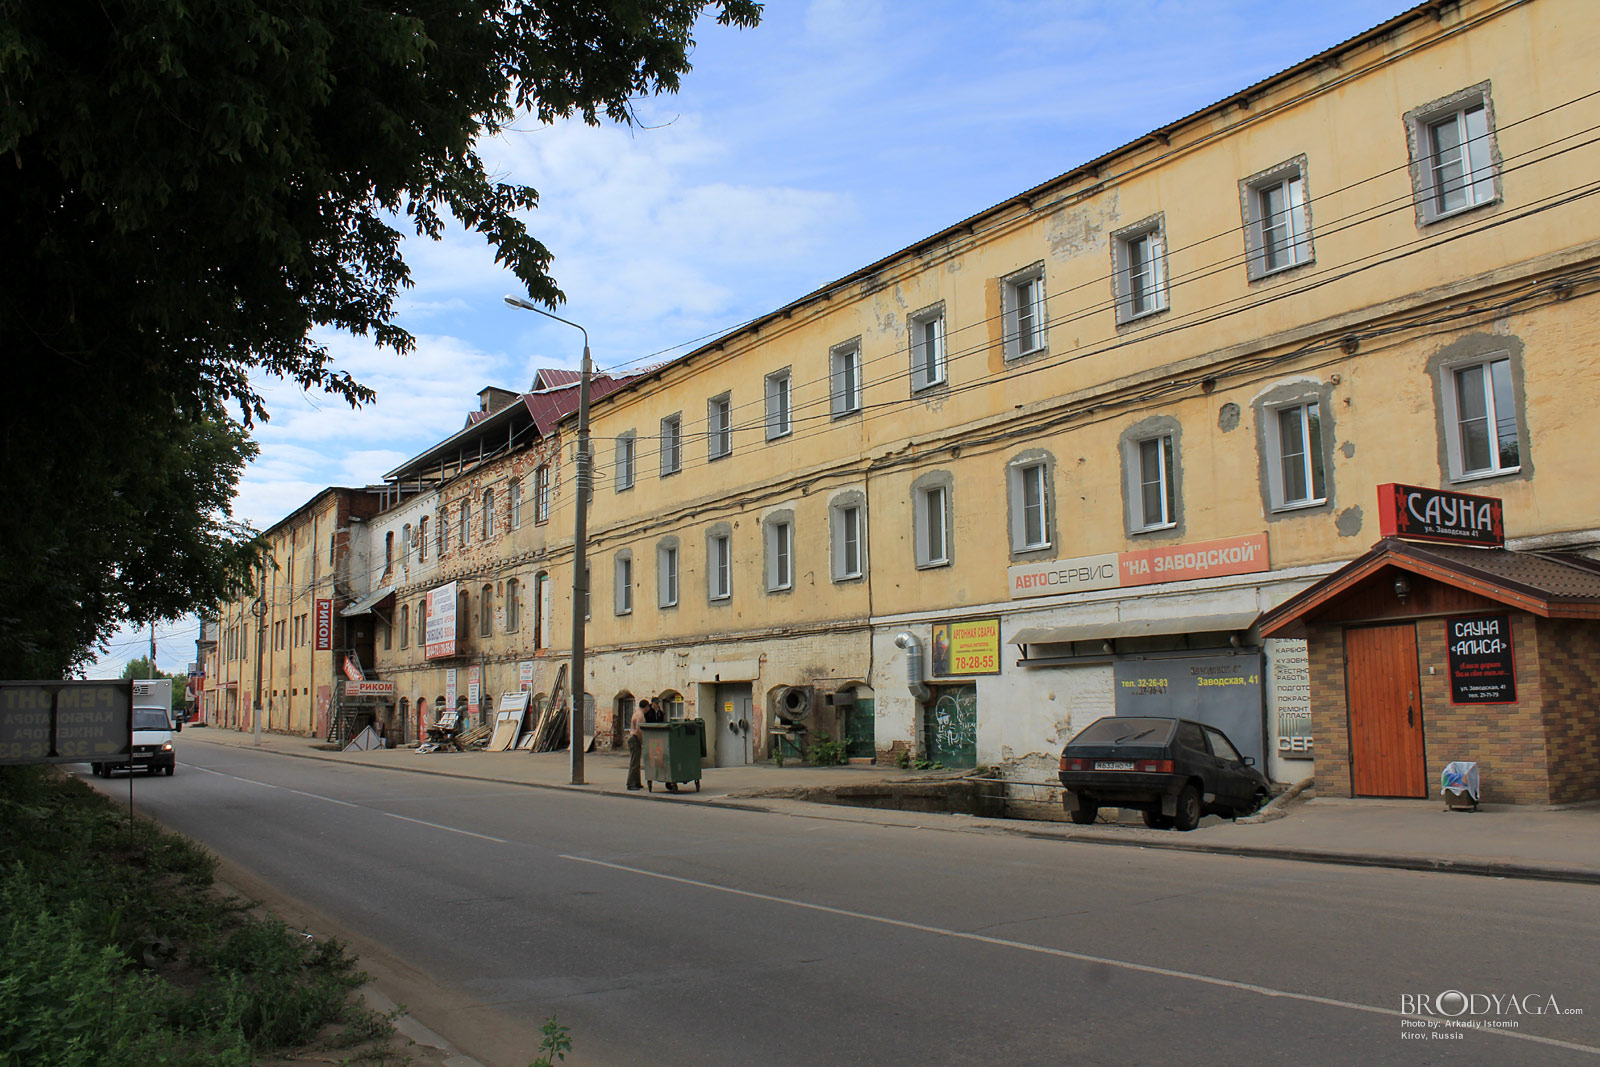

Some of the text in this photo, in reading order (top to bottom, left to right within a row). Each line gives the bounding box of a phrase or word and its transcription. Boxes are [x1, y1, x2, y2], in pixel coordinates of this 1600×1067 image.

[1407, 492, 1492, 531] САУНА
[1436, 525, 1470, 536] Заводская
[1471, 529, 1479, 537] 41
[1015, 542, 1262, 589] АВТОСЕРВИС "НА ЗАВОДСКОЙ"
[319, 601, 330, 648] РИКОМ
[1455, 620, 1499, 637] САУНА
[953, 626, 996, 640] АРГОННАЯ СВАРКА
[1450, 638, 1507, 655] «АЛИСА»
[956, 655, 993, 669] 78-28-55
[360, 683, 392, 691] РИКОМ
[1138, 679, 1168, 687] 32-26-83
[1197, 674, 1259, 687] Заводская, 41
